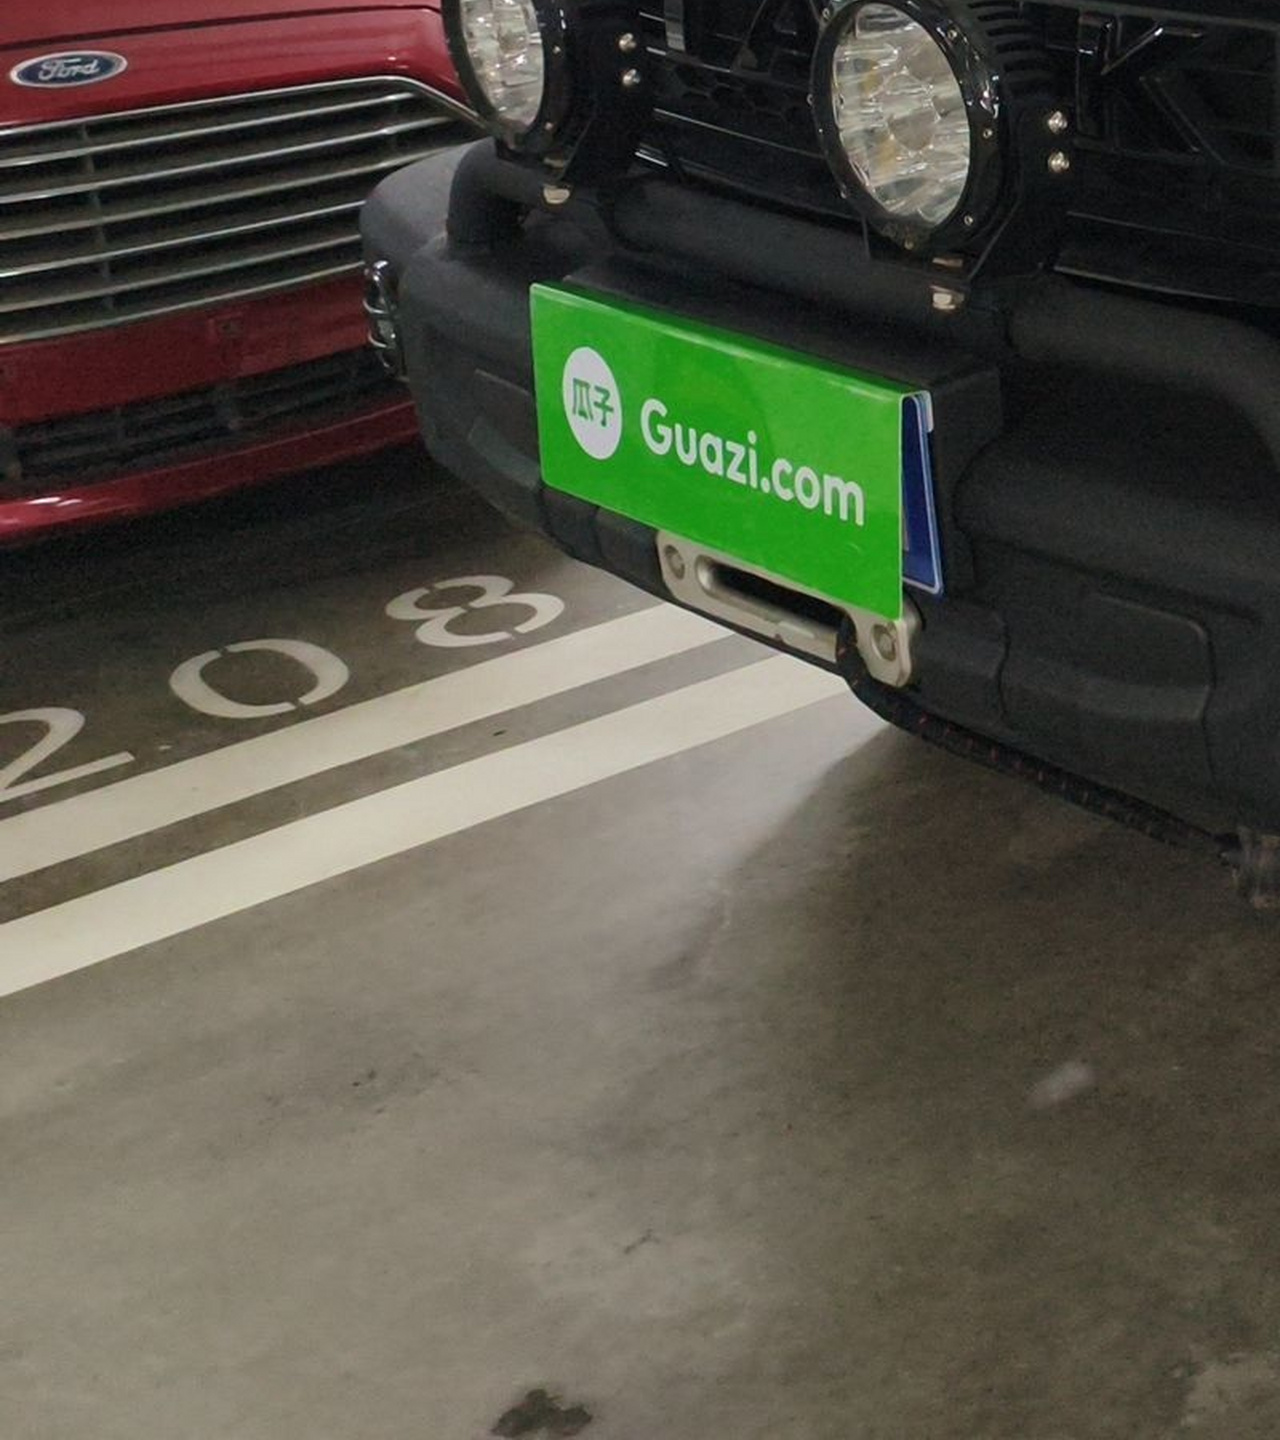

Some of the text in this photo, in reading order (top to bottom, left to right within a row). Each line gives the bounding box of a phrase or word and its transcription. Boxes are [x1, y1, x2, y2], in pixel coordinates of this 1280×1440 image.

[37, 56, 101, 81] Ford
[572, 377, 614, 427] 瓜子
[639, 397, 866, 526] Guazi.com
